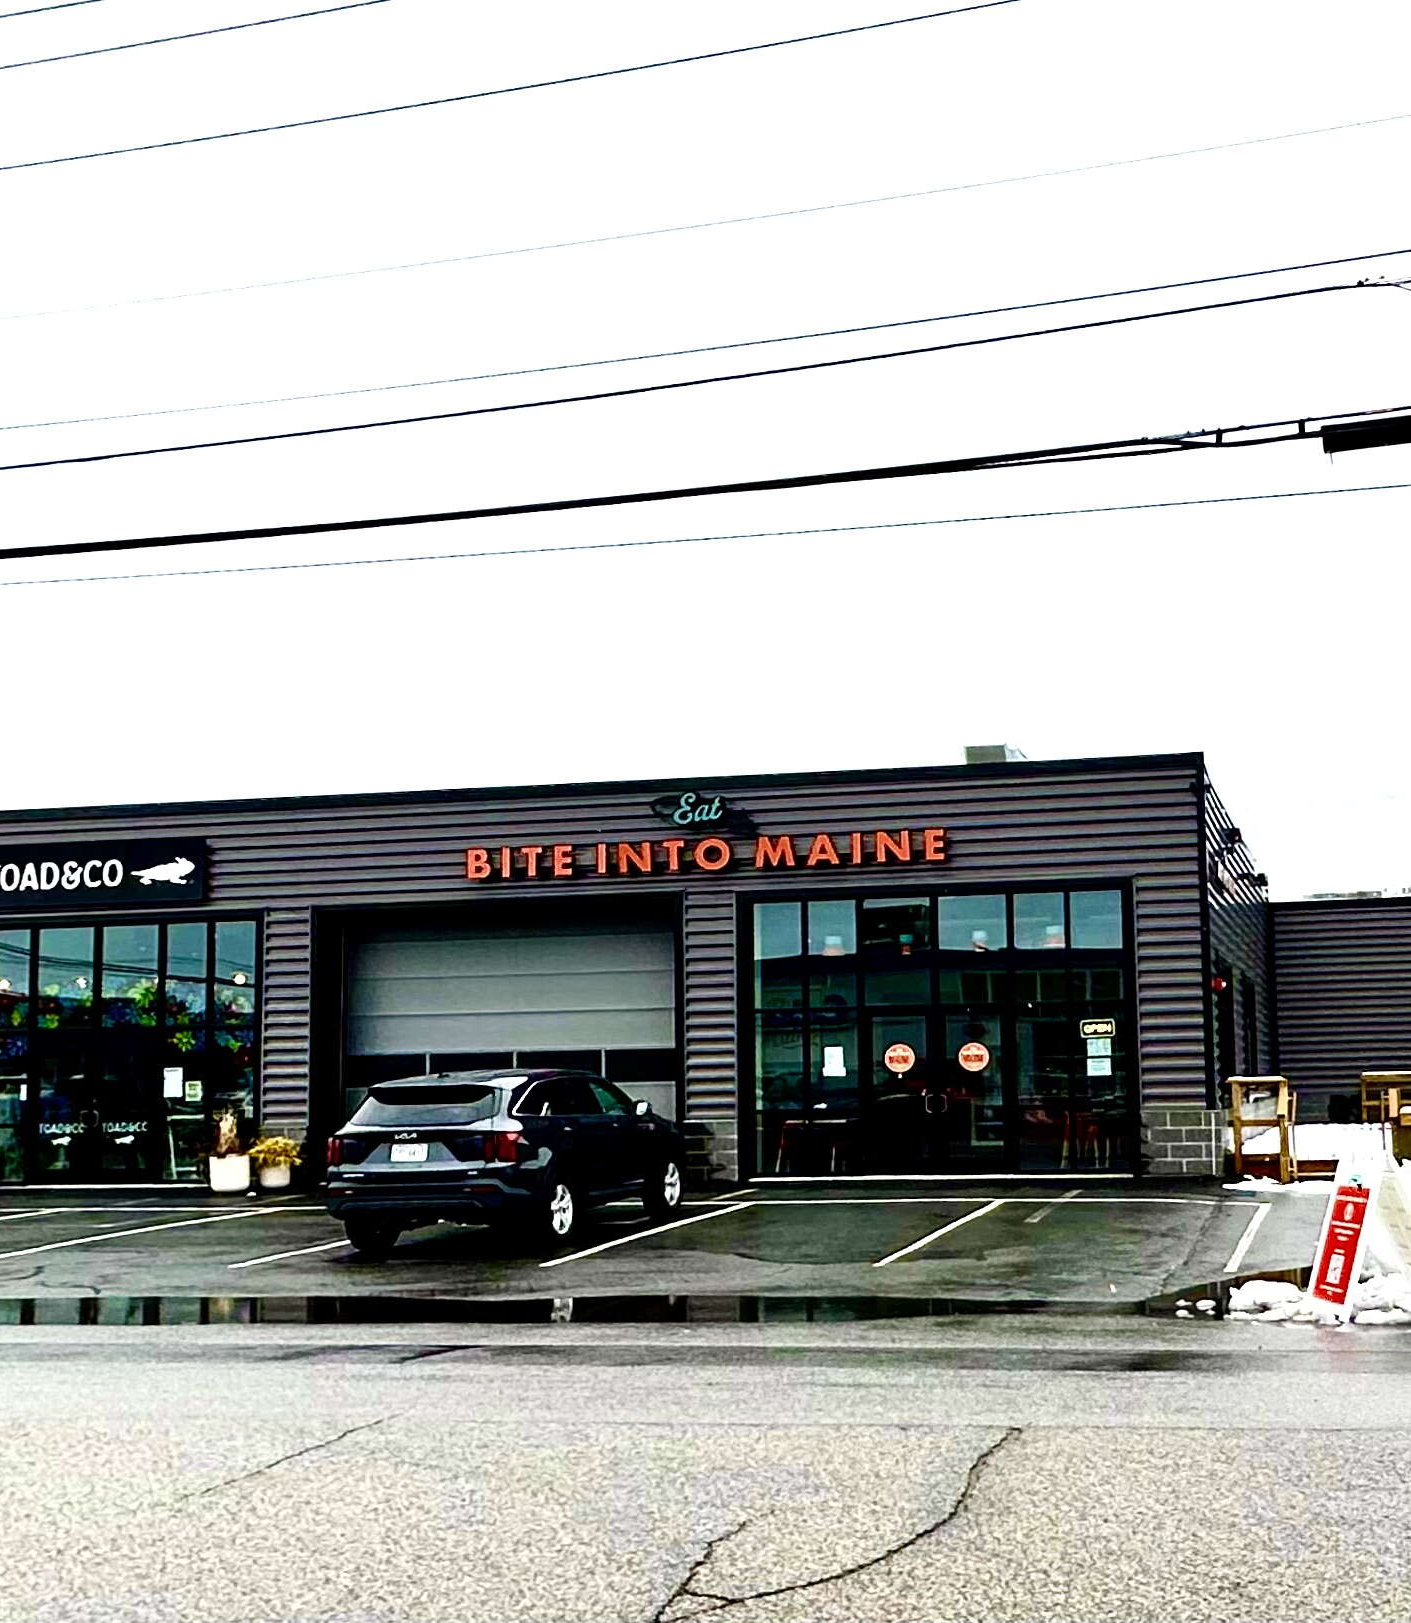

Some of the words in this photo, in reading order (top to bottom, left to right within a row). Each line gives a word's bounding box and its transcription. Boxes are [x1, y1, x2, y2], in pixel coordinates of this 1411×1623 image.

[673, 792, 724, 825] Eat
[466, 846, 574, 880] BITE
[596, 838, 731, 875] INTO
[754, 829, 946, 869] MAINE
